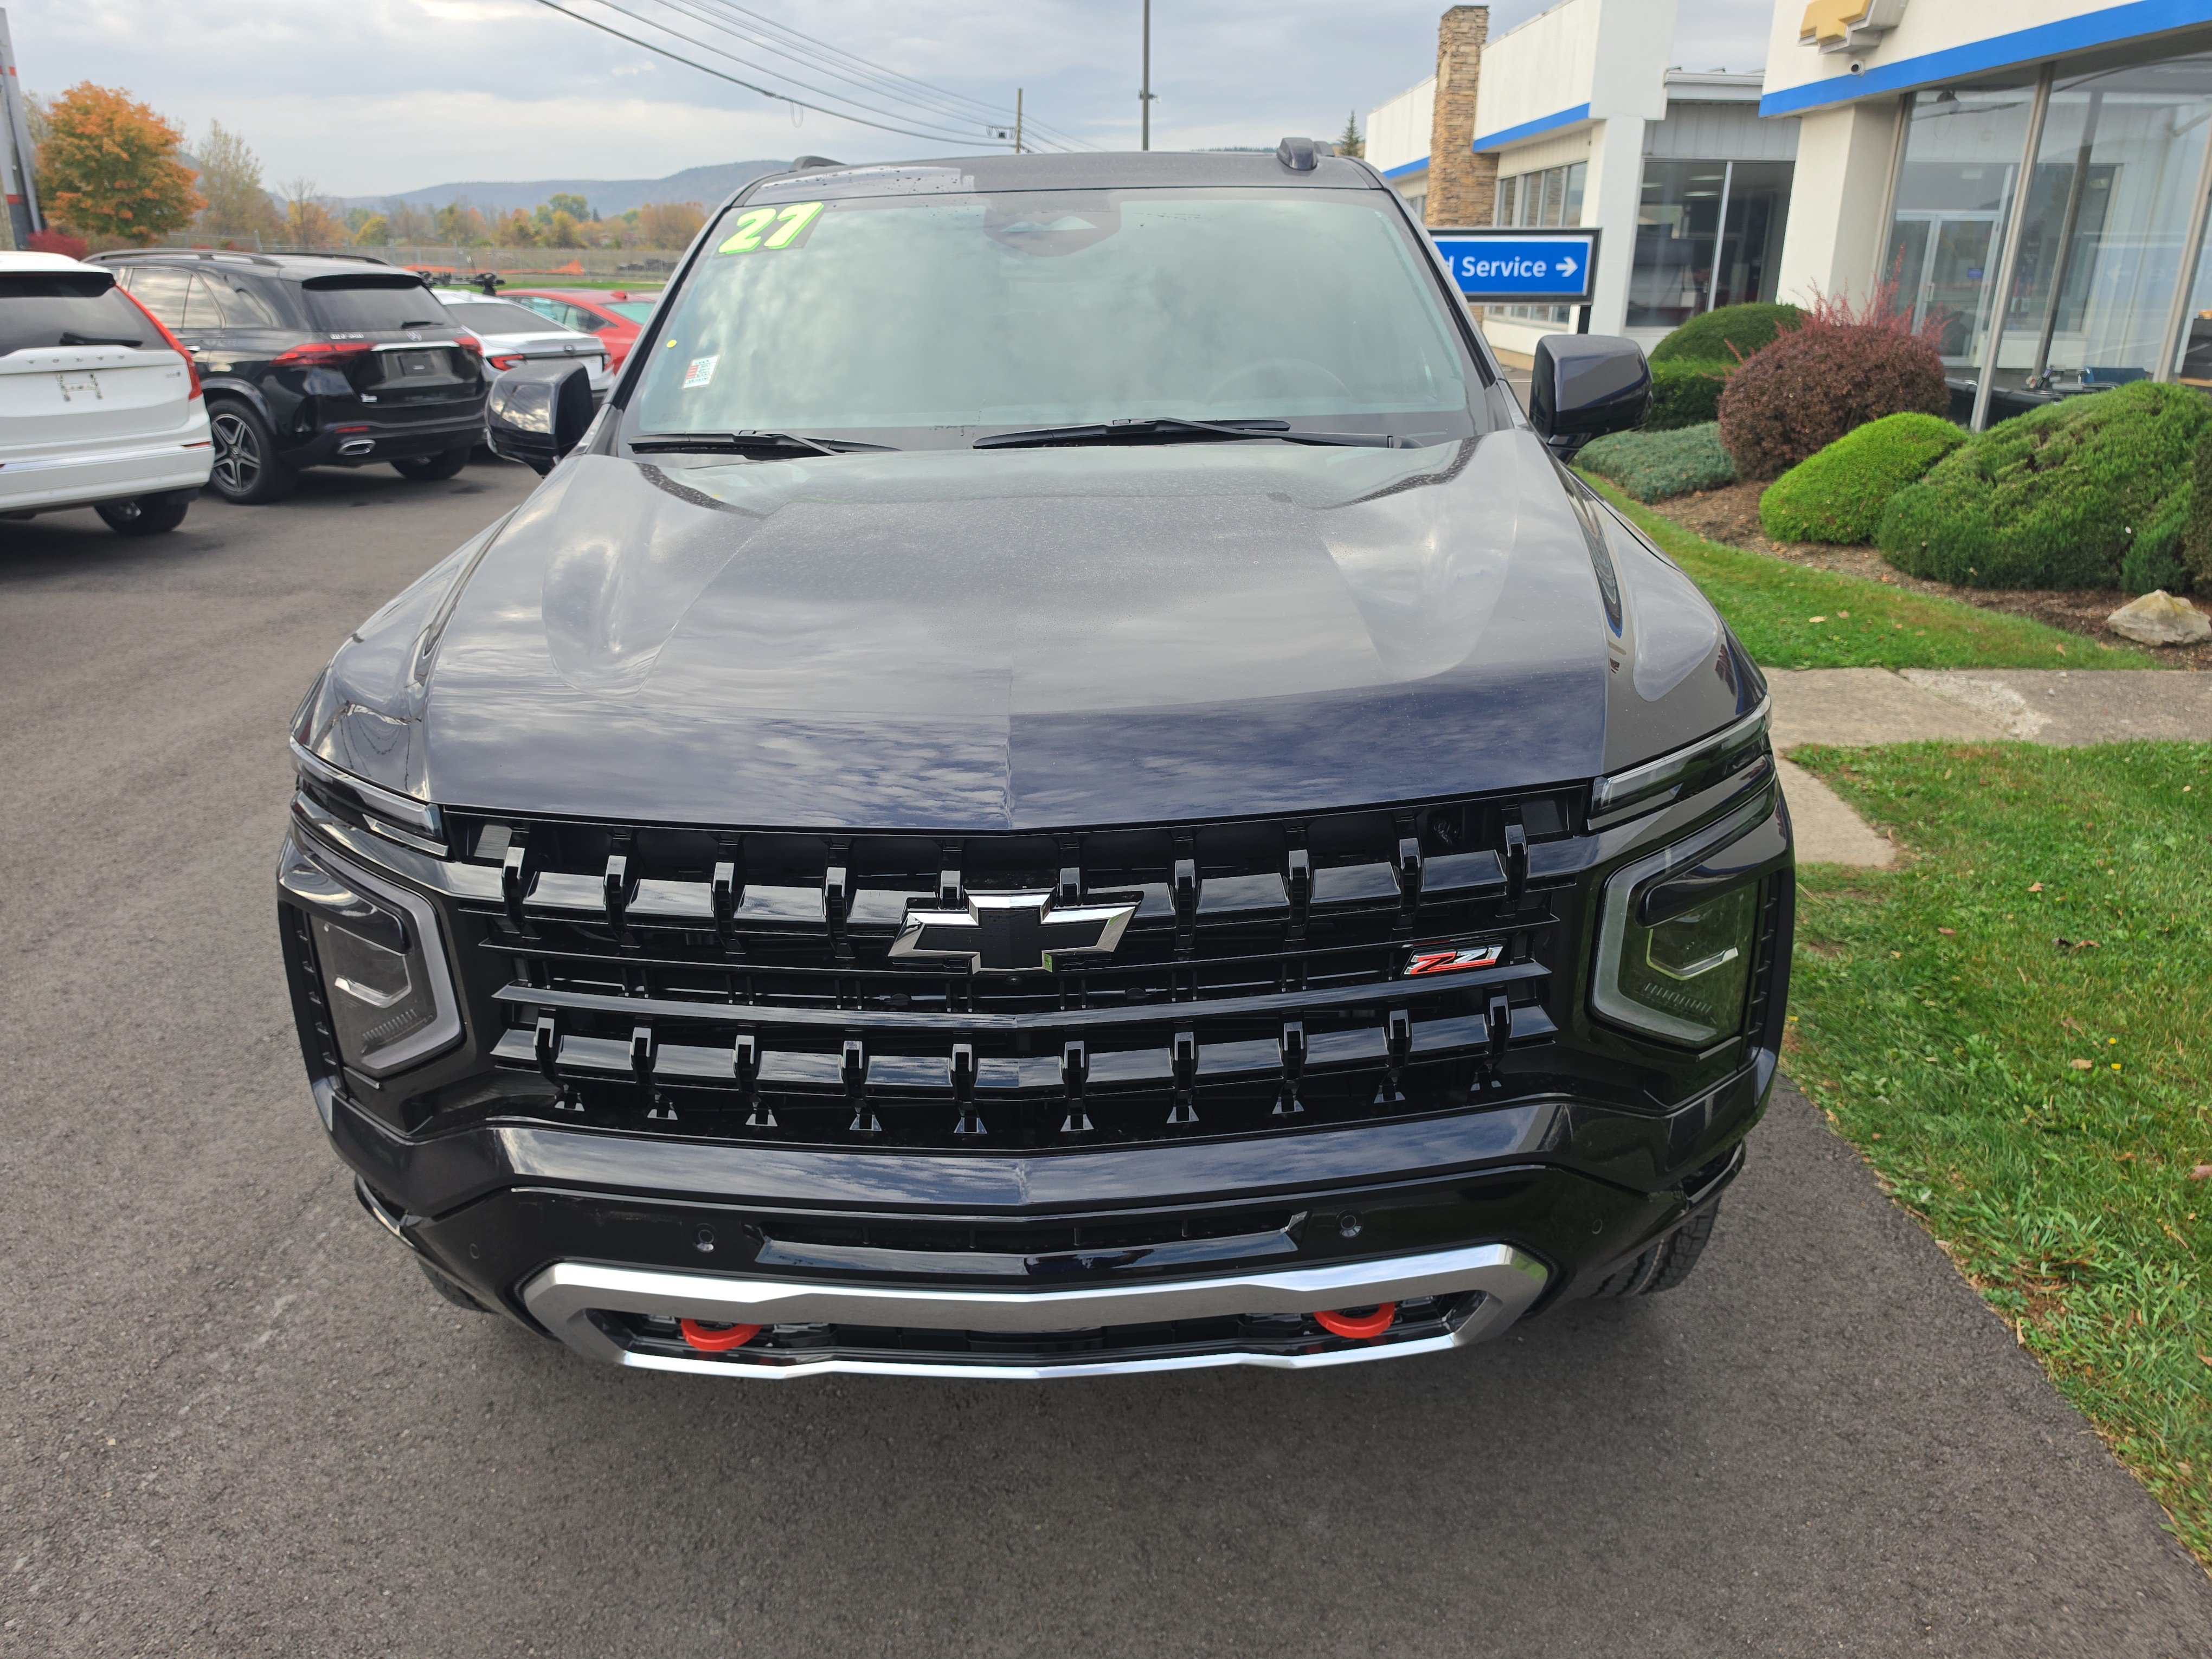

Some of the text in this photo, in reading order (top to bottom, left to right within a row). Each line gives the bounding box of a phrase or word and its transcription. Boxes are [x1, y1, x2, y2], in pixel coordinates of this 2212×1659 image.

[718, 202, 824, 254] 27
[1461, 255, 1547, 277] Service
[1404, 944, 1503, 974] Z71
